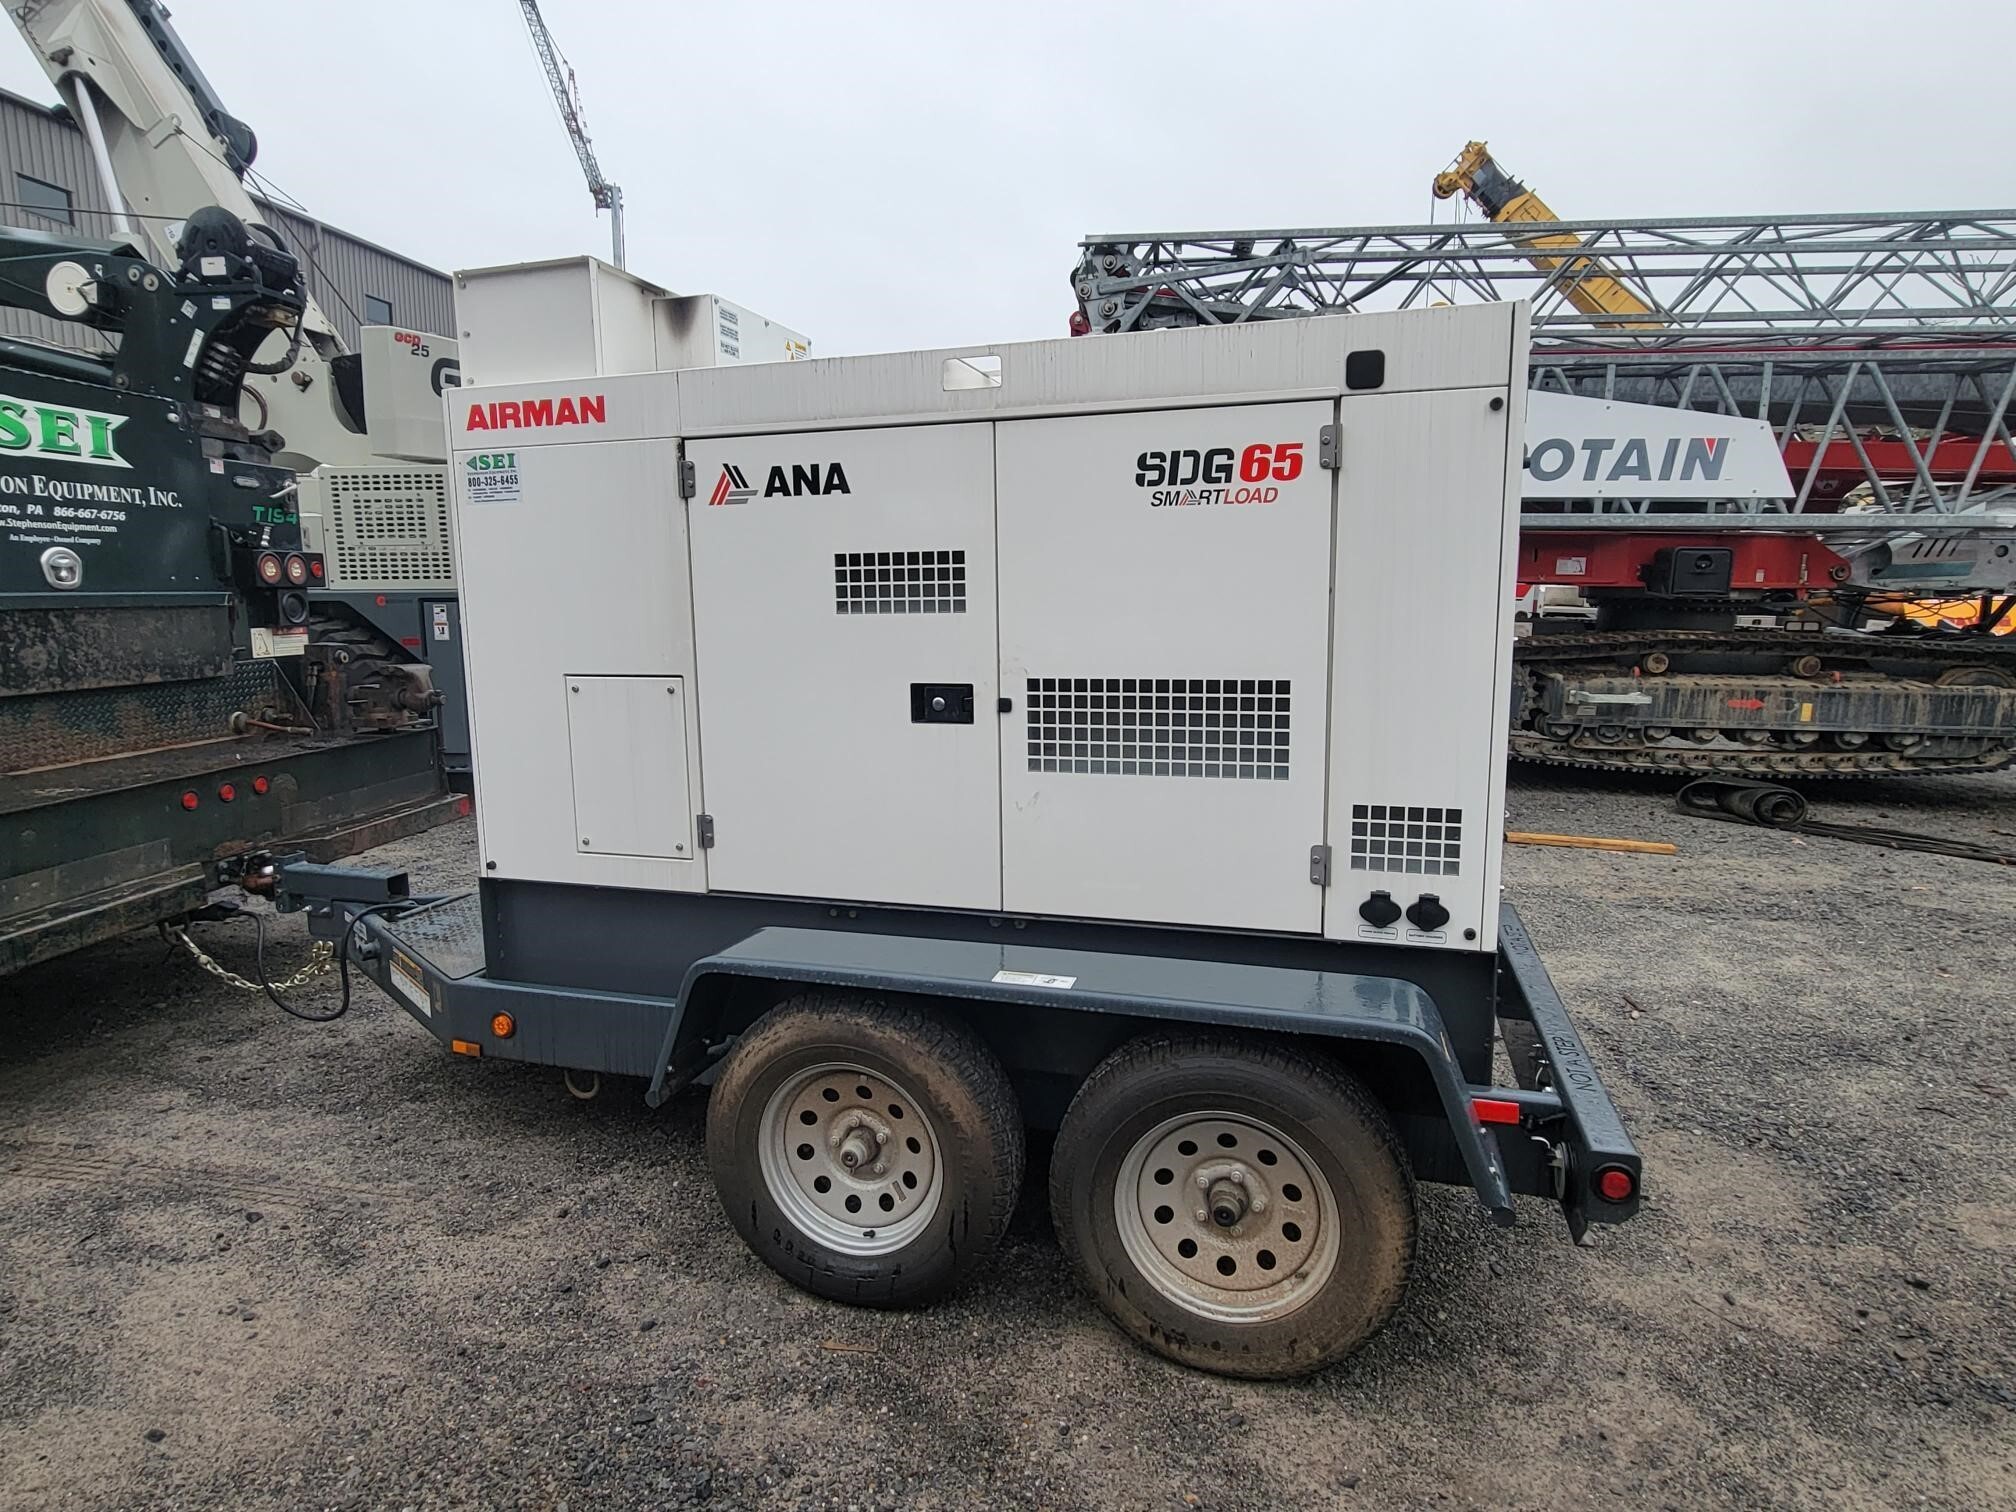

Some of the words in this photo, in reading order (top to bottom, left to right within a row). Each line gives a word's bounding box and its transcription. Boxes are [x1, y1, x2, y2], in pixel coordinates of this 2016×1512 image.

[411, 343, 430, 358] 25
[466, 395, 606, 431] AIRMAN
[0, 399, 115, 460] SEI
[478, 452, 517, 471] SEI
[1523, 437, 1730, 482] OTAIN
[30, 474, 146, 507] EQUIPMENT,
[147, 486, 183, 507] INC.
[467, 474, 519, 487] 800-325-6455
[763, 462, 851, 498] ANA
[27, 504, 43, 515] PA
[53, 506, 126, 521] 866-667-6756
[1552, 1036, 1580, 1057] STEP
[1565, 1059, 1587, 1068] A
[1565, 1067, 1597, 1092] NOT
